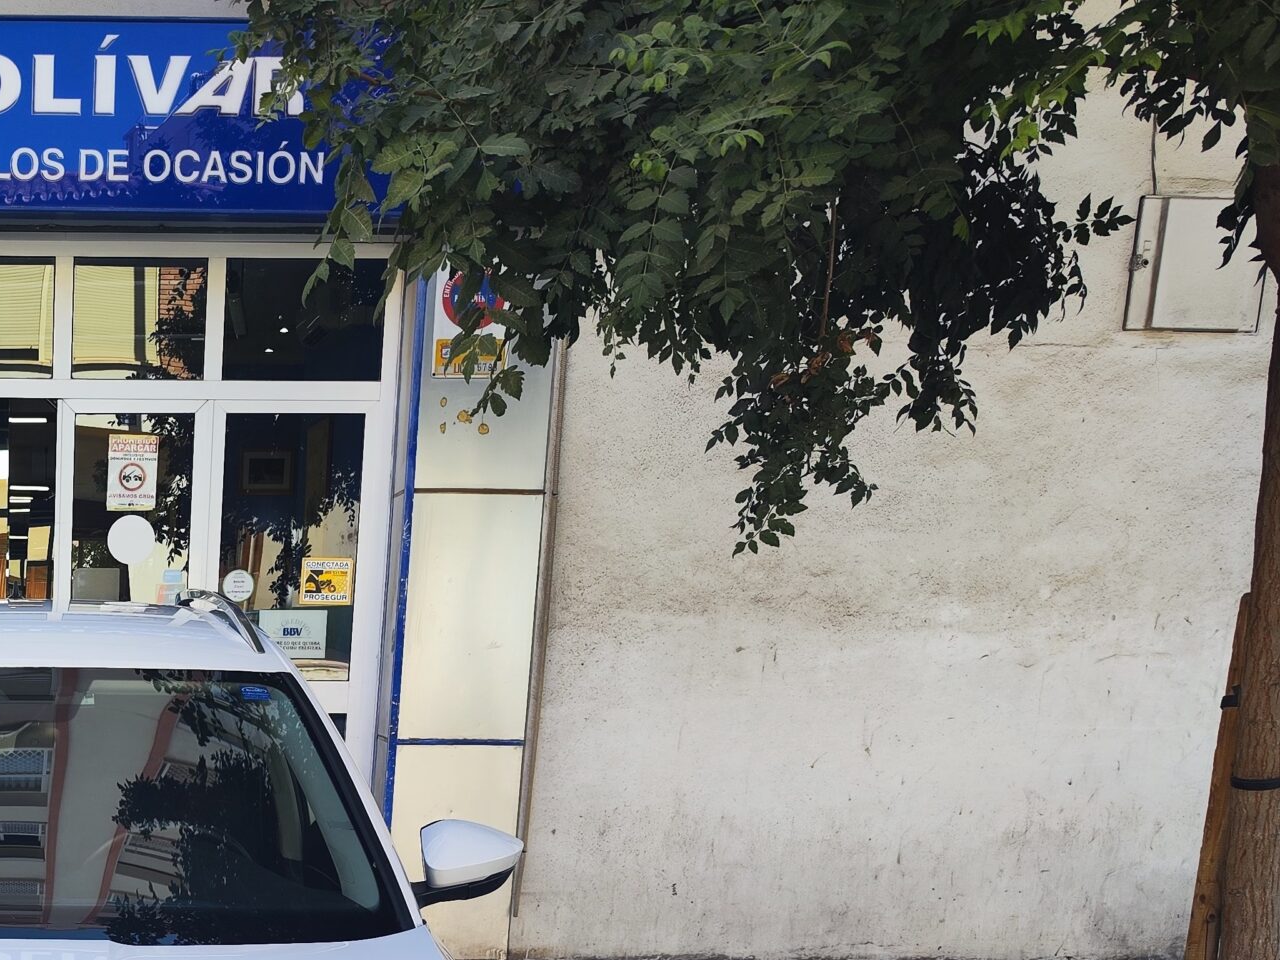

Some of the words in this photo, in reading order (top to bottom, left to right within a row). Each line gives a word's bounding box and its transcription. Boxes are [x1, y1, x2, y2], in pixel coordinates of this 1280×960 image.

[78, 147, 131, 184] DE
[142, 141, 326, 186] OCASIÓN
[111, 443, 157, 452] APARCAR
[303, 593, 348, 601] PROSEGUR
[282, 627, 303, 637] BBV
